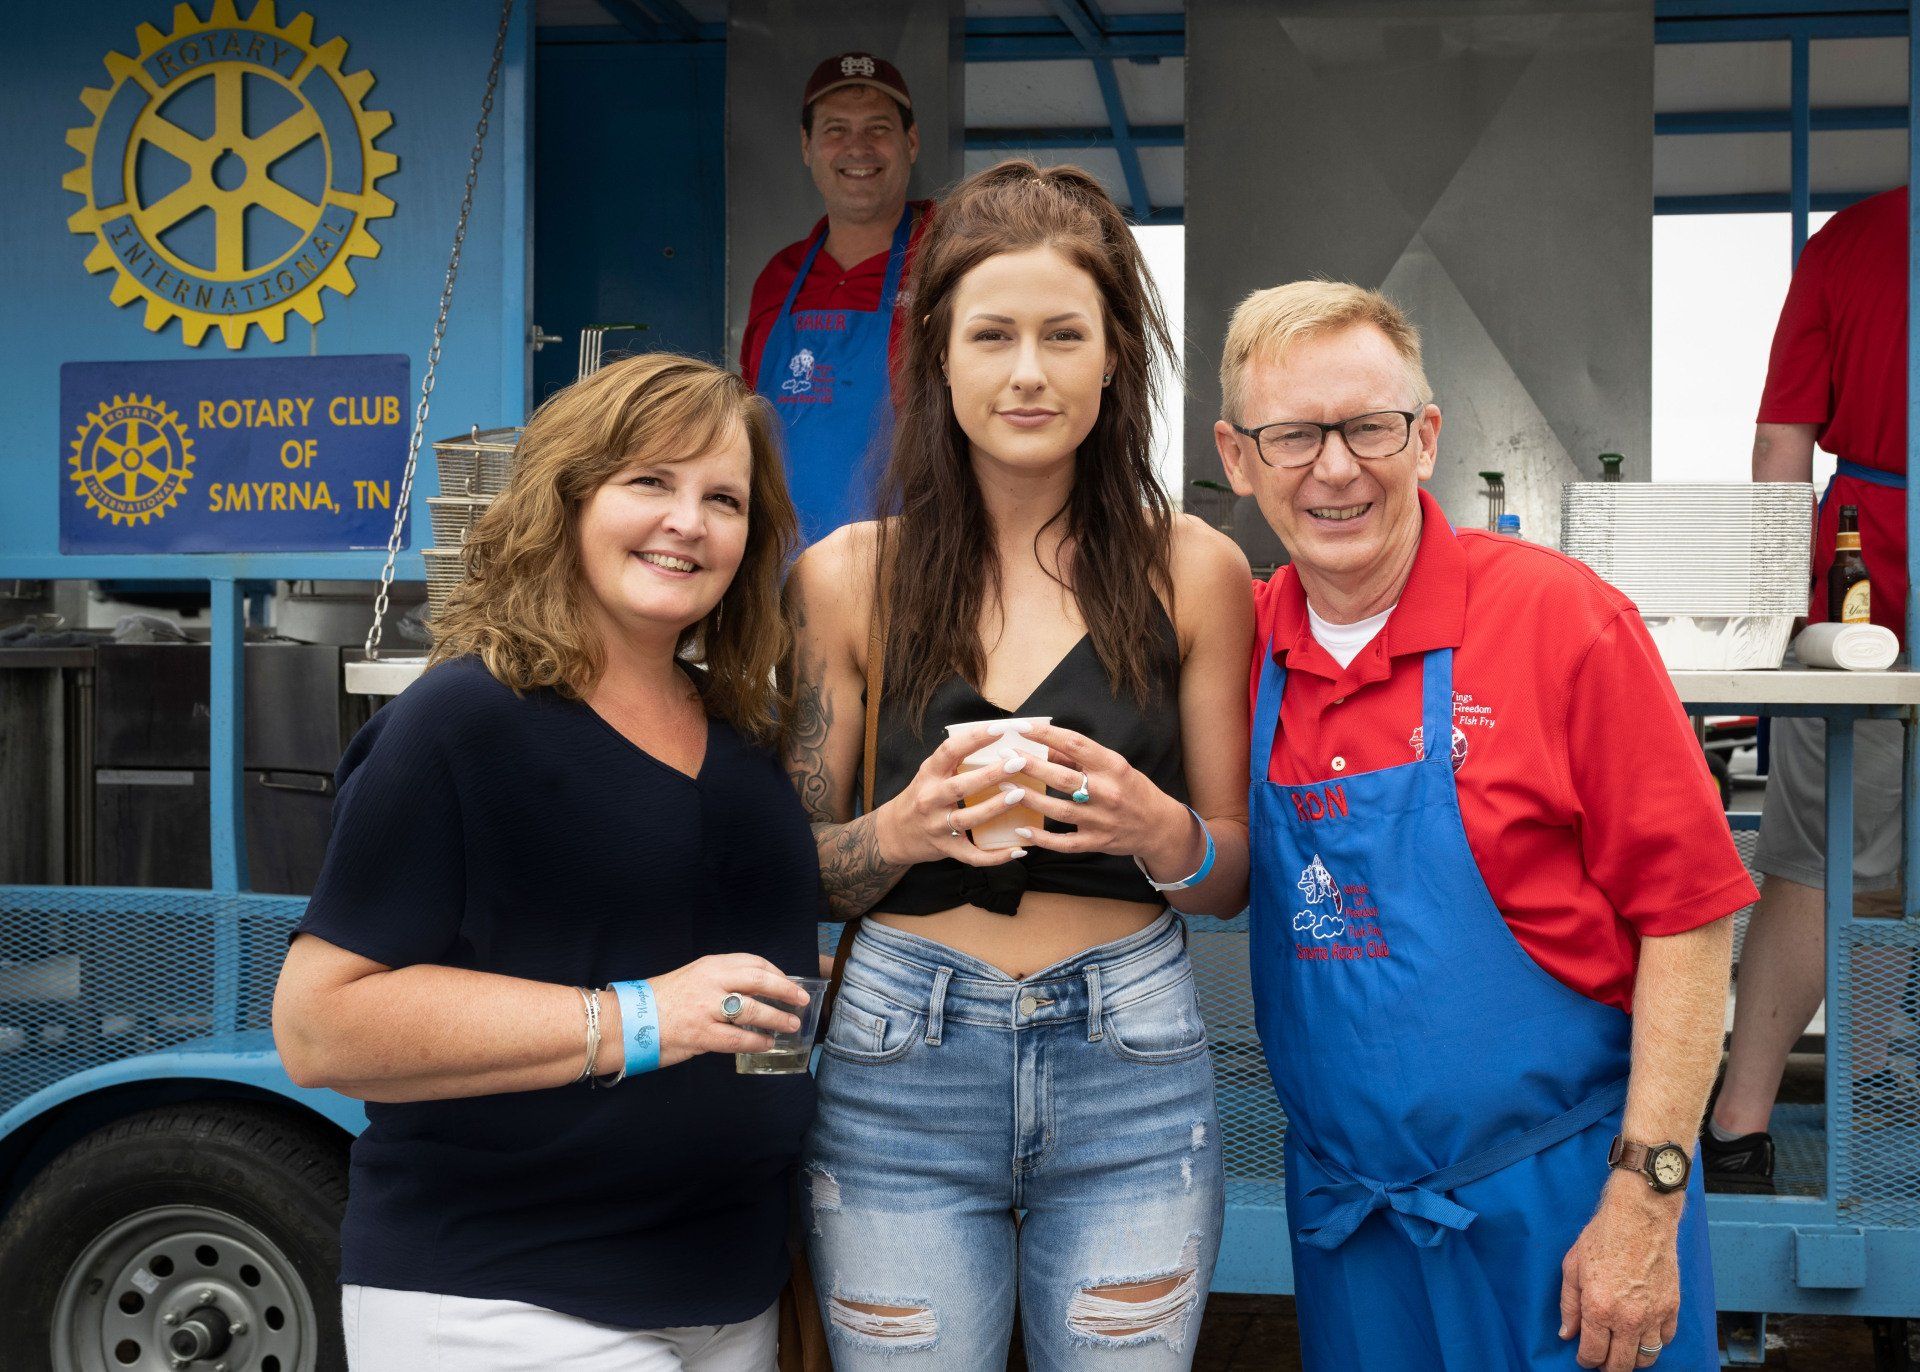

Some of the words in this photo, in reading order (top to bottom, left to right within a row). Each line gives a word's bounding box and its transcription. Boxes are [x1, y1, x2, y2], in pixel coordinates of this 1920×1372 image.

[155, 32, 290, 78] ROTARY
[111, 222, 345, 310] INTERNATIONAL
[796, 314, 846, 331] BAKER
[107, 408, 157, 422] ROTARY
[198, 398, 315, 429] ROTARY
[328, 395, 401, 426] CLUB
[280, 439, 318, 469] OF
[88, 481, 176, 511] INTERNATIONAL
[208, 481, 341, 514] SMYRNA,
[353, 480, 391, 509] TN
[1452, 702, 1492, 717] Freedom
[1479, 716, 1496, 729] Fry
[1291, 785, 1349, 821] RON
[1366, 940, 1391, 959] Club
[637, 990, 649, 1018] Wings
